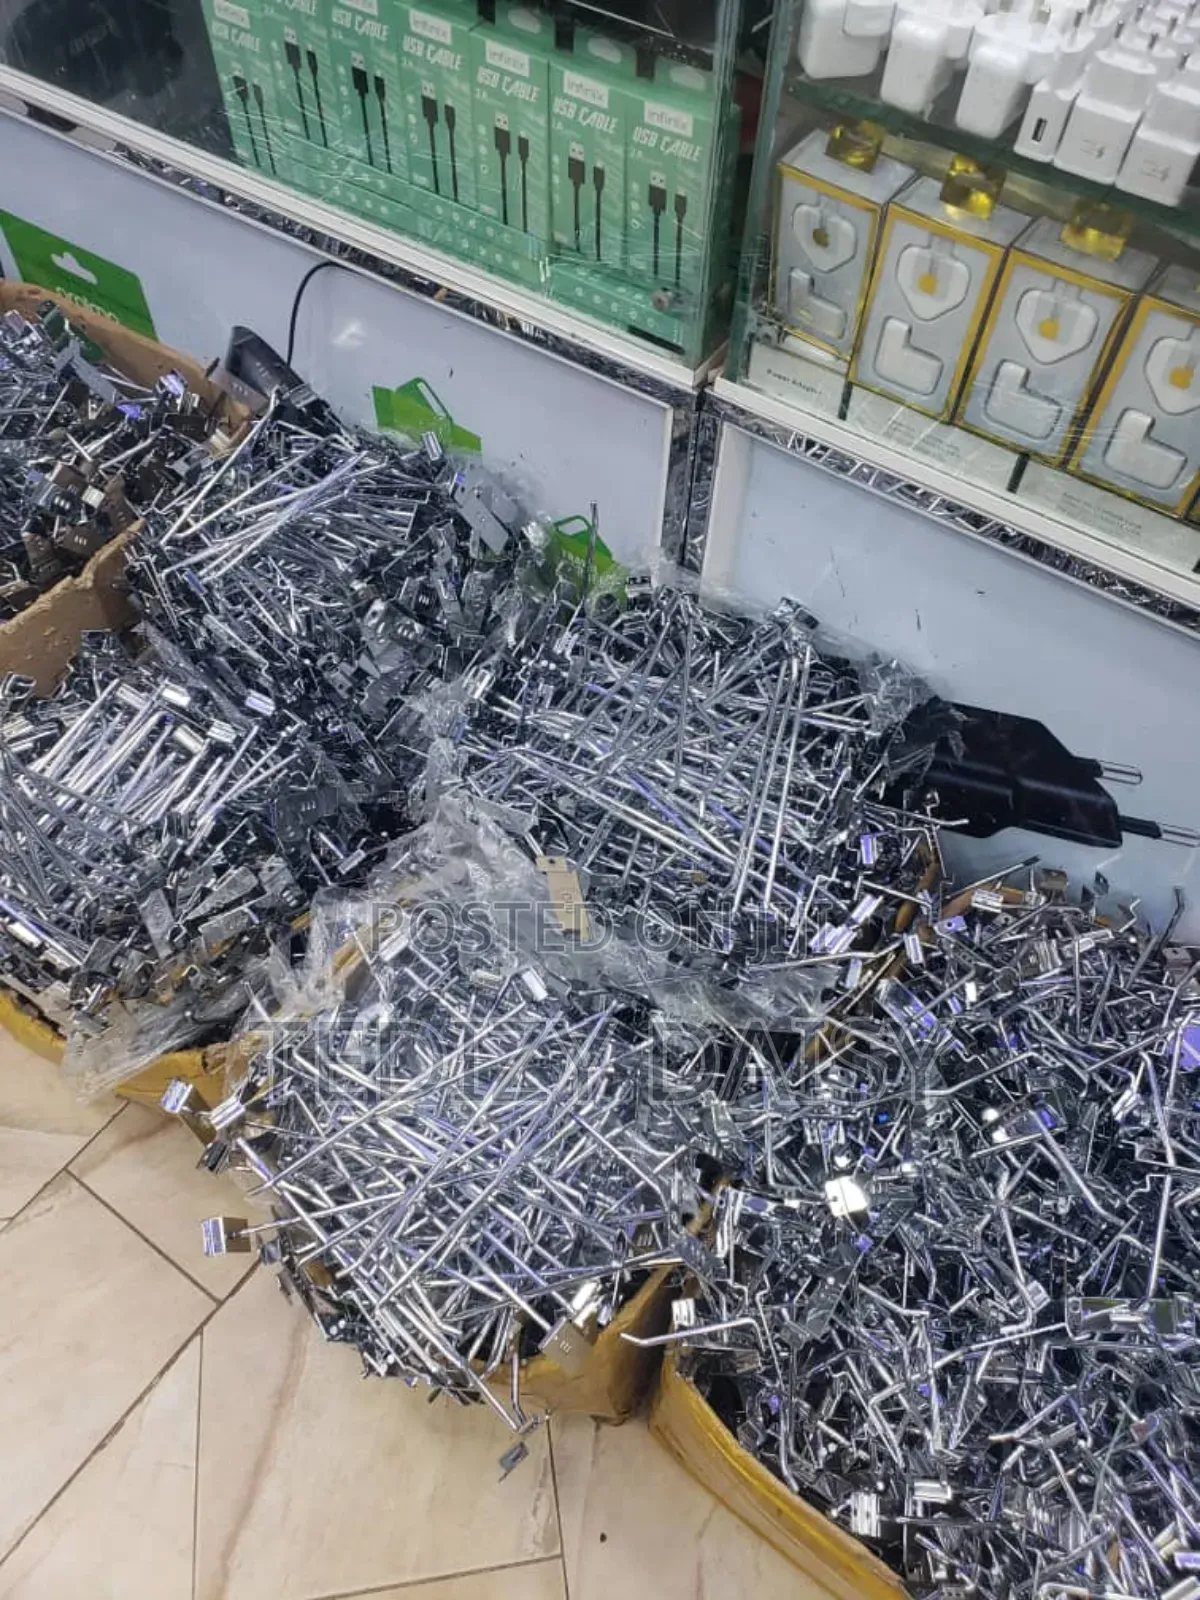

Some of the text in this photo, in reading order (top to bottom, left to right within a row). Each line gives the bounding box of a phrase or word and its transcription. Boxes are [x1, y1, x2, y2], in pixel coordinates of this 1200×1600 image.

[354, 14, 389, 41] CABLE
[402, 35, 425, 57] USB
[426, 44, 465, 71] CABLE
[477, 66, 541, 103] USB CABLE
[552, 97, 578, 119] USB
[578, 106, 619, 135] CABLE
[632, 126, 659, 148] USB
[660, 136, 704, 162] CABLE
